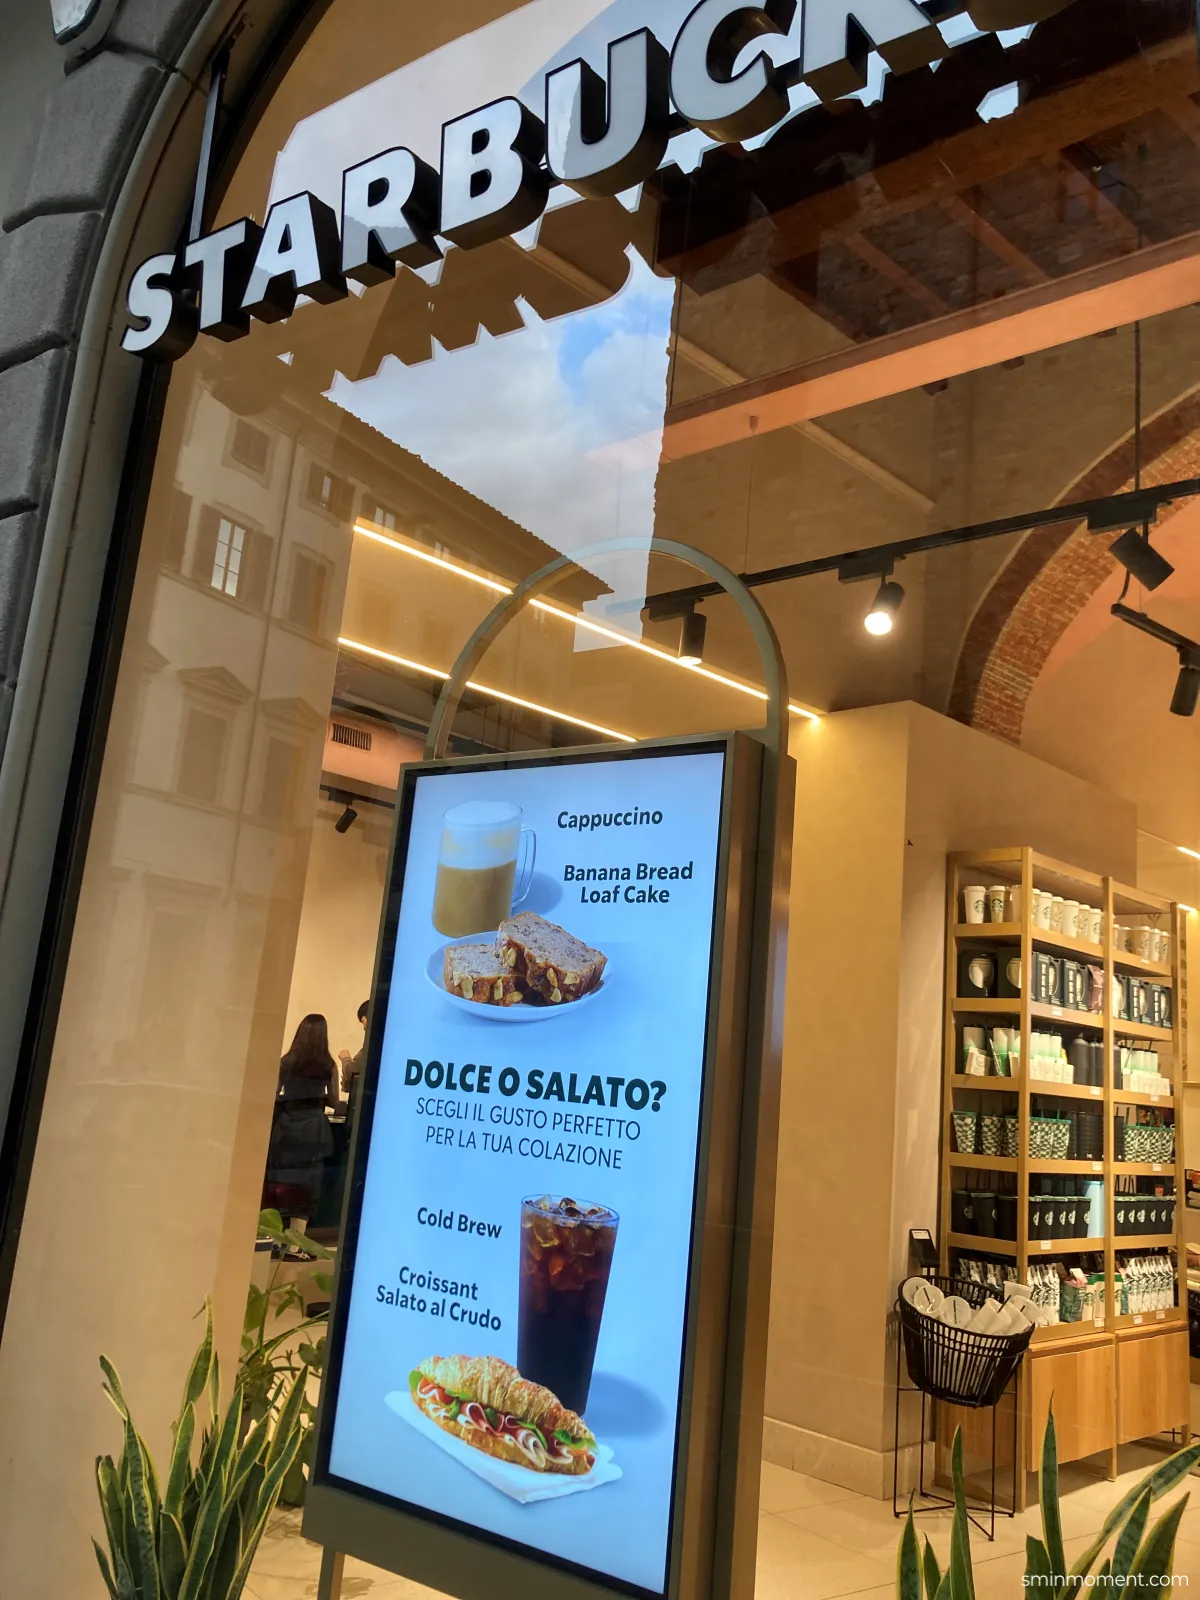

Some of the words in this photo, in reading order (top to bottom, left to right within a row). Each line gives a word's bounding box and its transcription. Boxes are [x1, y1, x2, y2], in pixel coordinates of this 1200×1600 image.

[557, 806, 663, 831] Cappuccino
[563, 864, 631, 882] Banana
[636, 860, 694, 881] Bread
[580, 884, 621, 904] Loaf
[623, 884, 670, 904] Cake
[404, 1058, 493, 1094] DOLCE
[498, 1066, 521, 1097] O
[525, 1069, 667, 1113] SALATO?
[416, 1097, 469, 1120] SCEGLI
[472, 1103, 485, 1122] IL
[489, 1105, 548, 1129] GUSTO
[552, 1112, 641, 1141] PERFETTO
[425, 1125, 455, 1146] PER
[458, 1129, 477, 1150] LA
[482, 1132, 513, 1155] TUA
[518, 1137, 623, 1170] COLAZIONE
[417, 1206, 454, 1230] Cold
[457, 1213, 502, 1239] Brew
[399, 1266, 479, 1301] Croissant
[376, 1284, 427, 1313] Salato
[430, 1298, 446, 1318] al
[449, 1302, 502, 1331] Crudo
